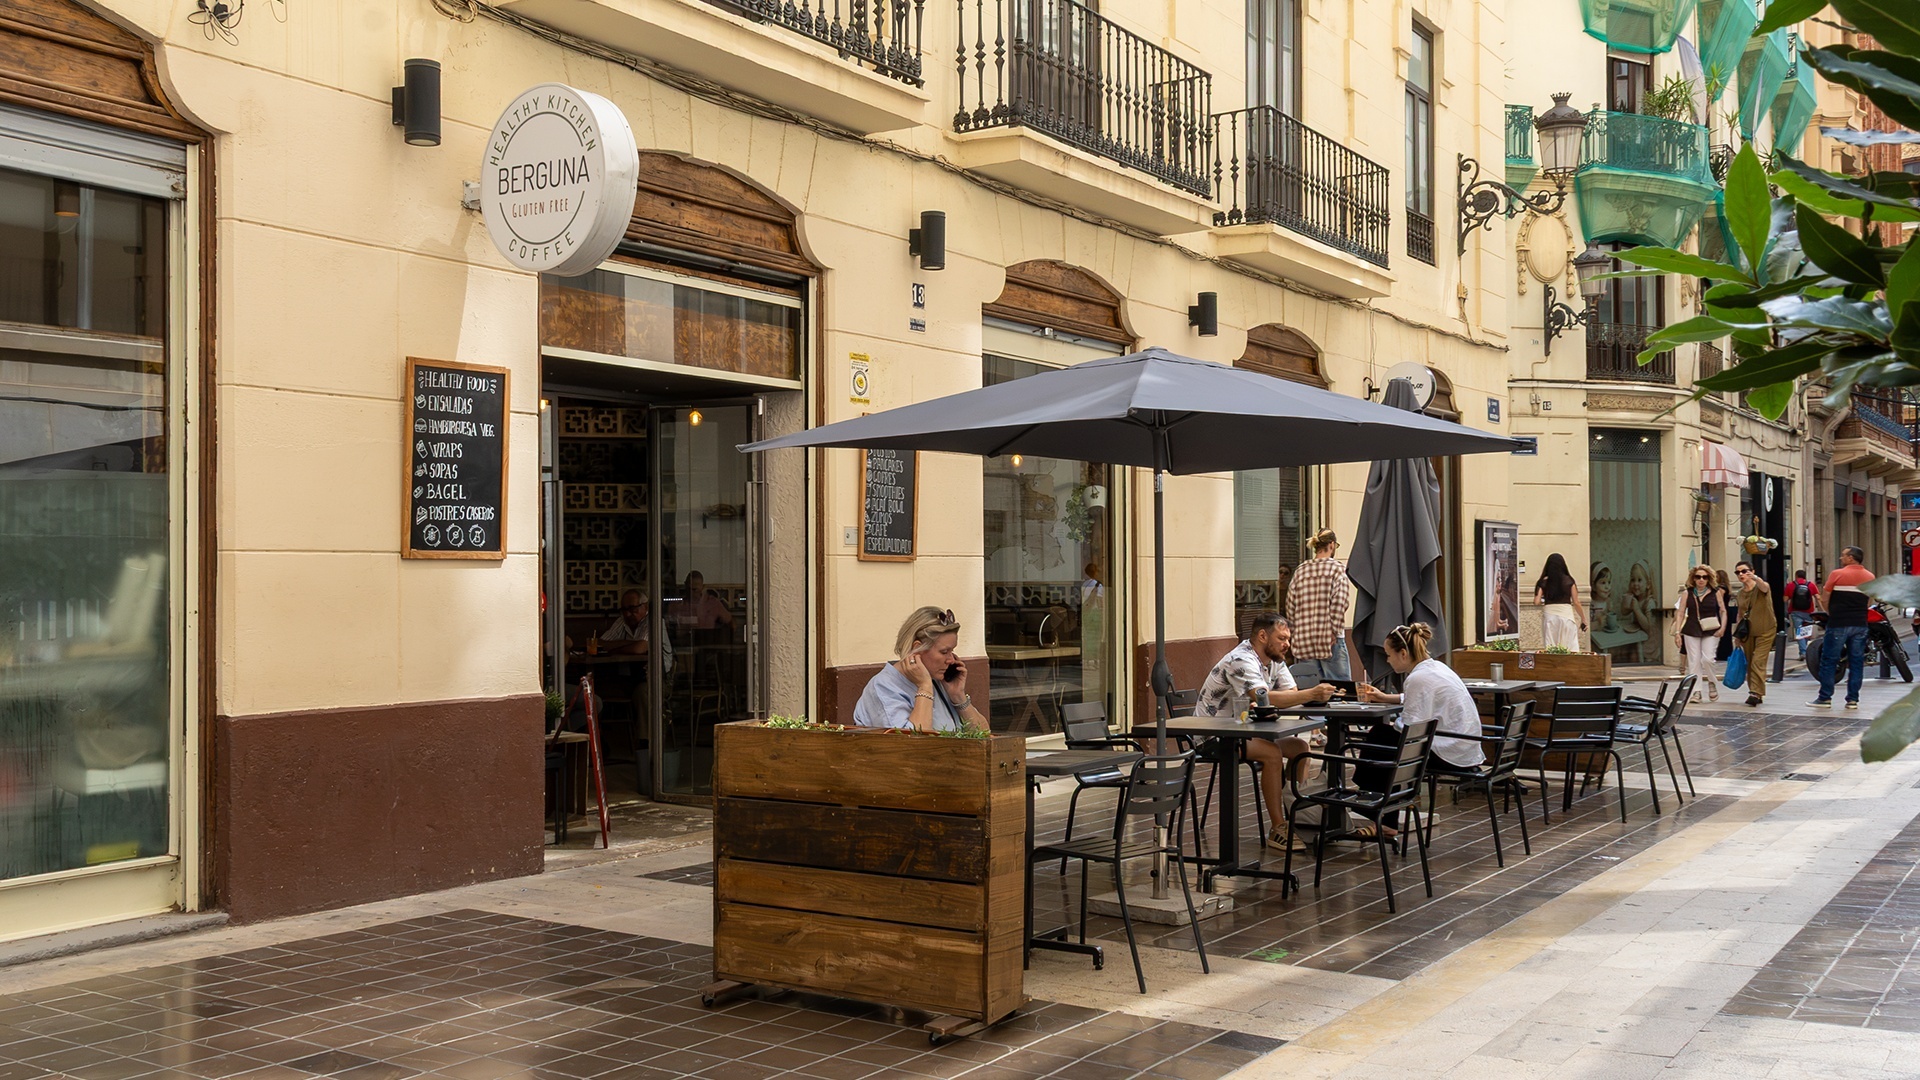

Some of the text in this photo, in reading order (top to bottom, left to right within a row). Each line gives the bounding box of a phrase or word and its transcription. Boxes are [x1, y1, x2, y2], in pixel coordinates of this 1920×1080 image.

[490, 95, 597, 167] HEALTHY KITCHEN
[499, 155, 590, 195] BERGUNA
[512, 198, 569, 218] GLUTEN FREE
[509, 231, 575, 262] COFFEE
[912, 284, 925, 304] 13
[424, 371, 489, 392] HEALTHY FOOD
[428, 395, 473, 415] ENSALADAS
[428, 419, 477, 437] HAMBURGUESA
[428, 441, 463, 458] WRAPS
[429, 462, 458, 479] SOPAS
[426, 483, 466, 500] BAGEL
[428, 505, 494, 520] POSTRES CASEROS
